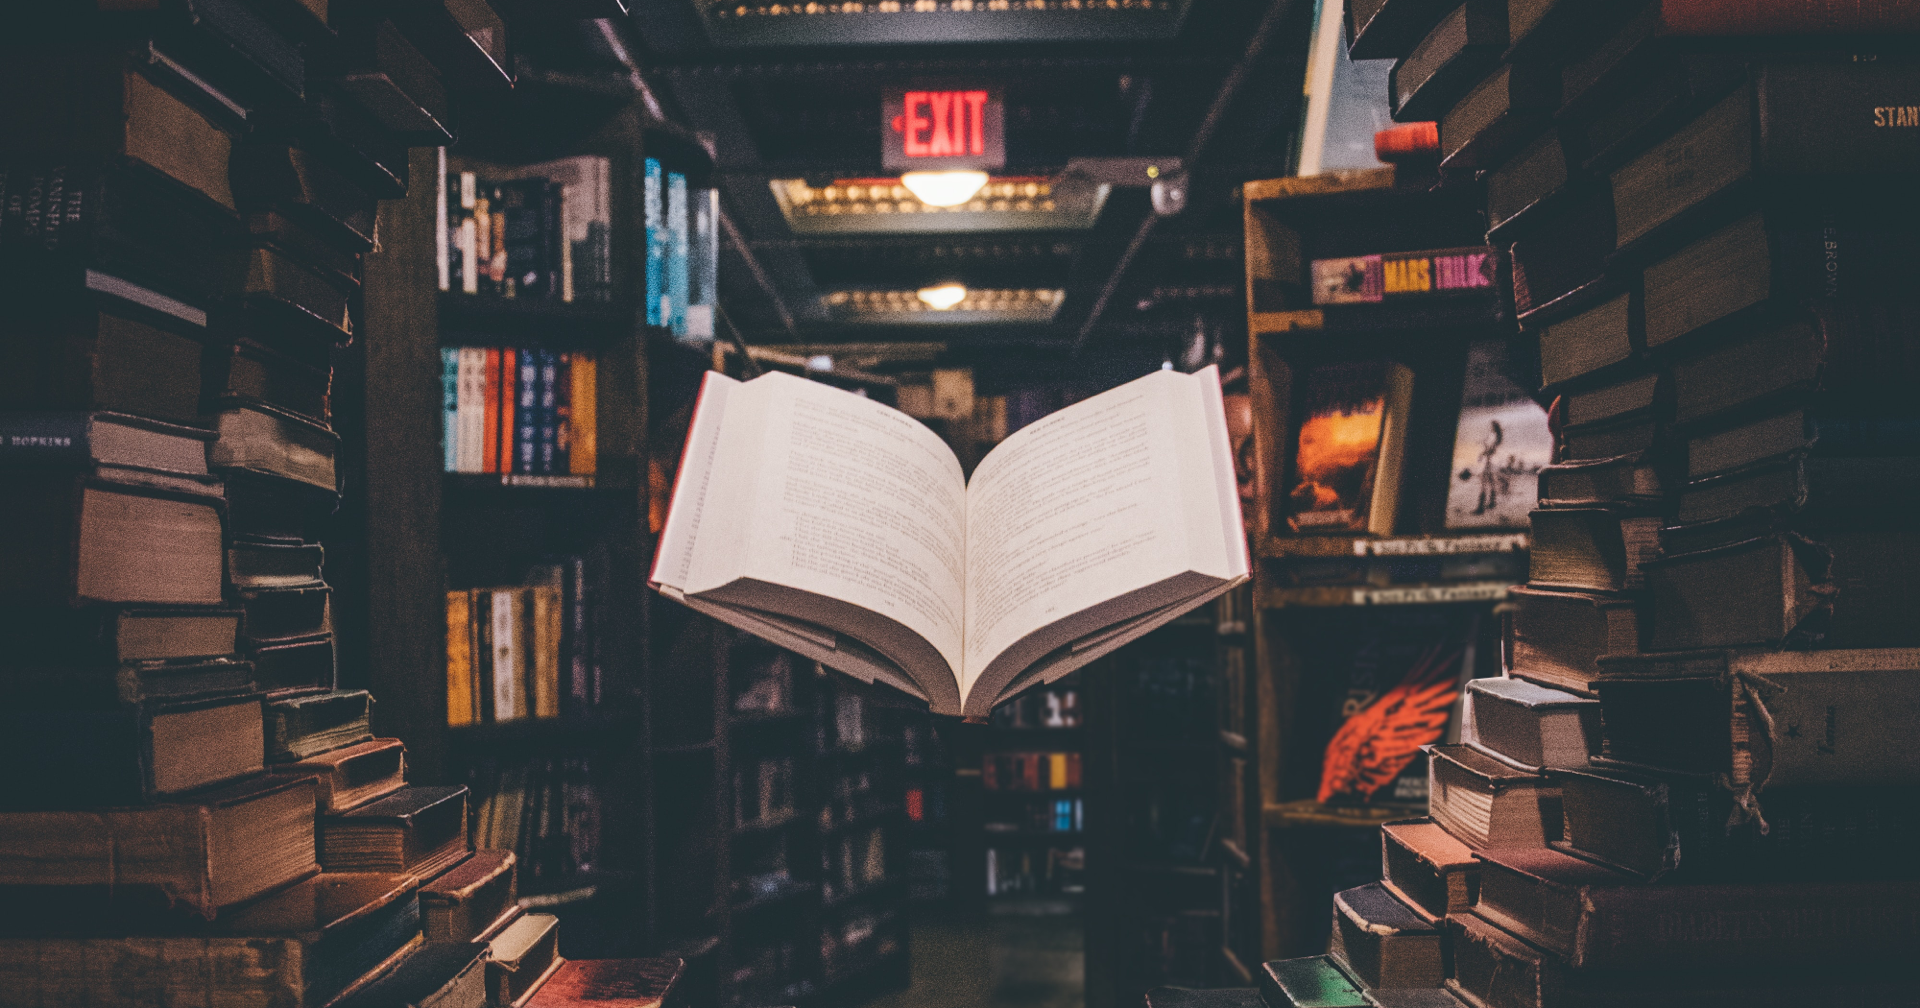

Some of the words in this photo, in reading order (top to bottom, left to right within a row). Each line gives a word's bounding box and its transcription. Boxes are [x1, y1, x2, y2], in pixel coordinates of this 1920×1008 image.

[904, 90, 988, 157] EXIT
[1873, 105, 1920, 128] STAN
[65, 191, 83, 223] THE
[1384, 258, 1432, 293] MARS
[11, 435, 72, 448] HOPKINS
